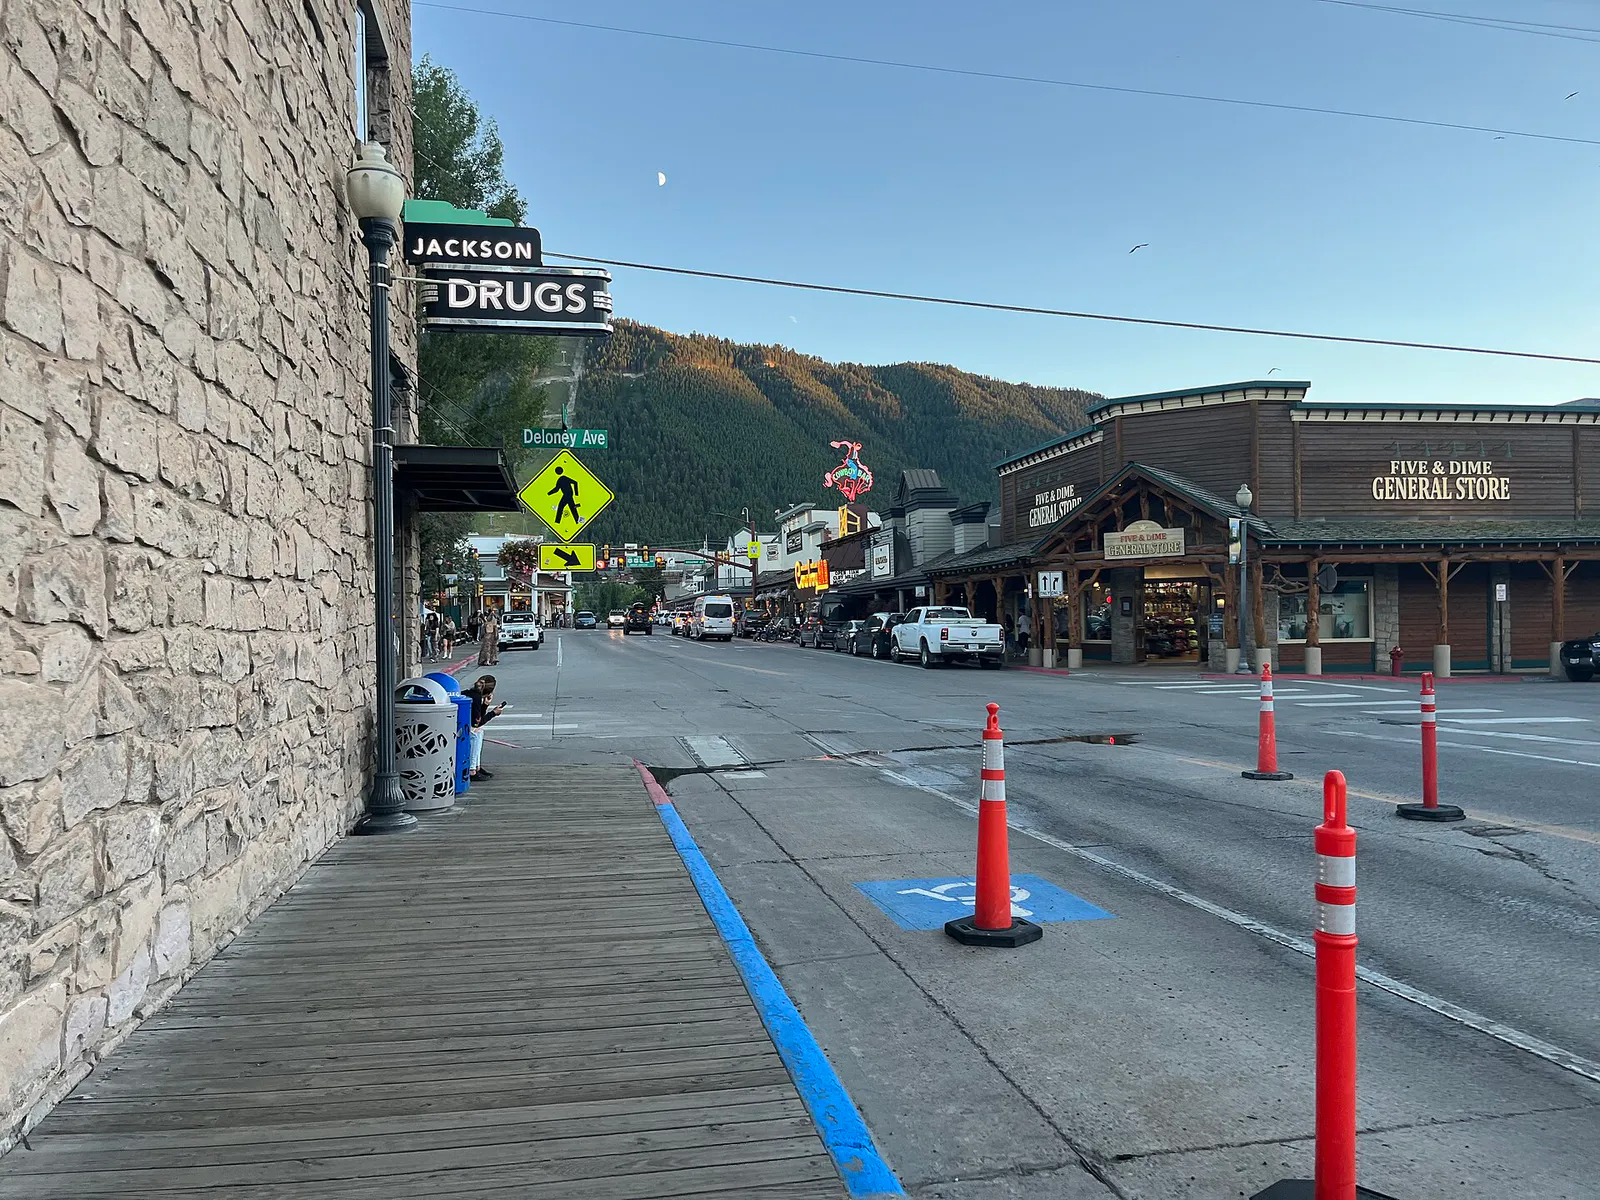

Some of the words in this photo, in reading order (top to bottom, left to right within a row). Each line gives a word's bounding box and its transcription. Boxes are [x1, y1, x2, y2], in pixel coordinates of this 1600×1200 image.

[412, 237, 532, 260] JACKSON
[448, 278, 587, 314] DRUGS
[523, 428, 577, 448] Deloney
[582, 429, 606, 445] Ave
[1390, 460, 1428, 475] FIVE
[1431, 460, 1445, 475] &
[1449, 460, 1492, 475] DIME
[1035, 491, 1050, 506] FIVE
[1050, 490, 1056, 502] &
[1056, 484, 1074, 500] DIME
[1372, 477, 1452, 500] GENERAL
[1455, 477, 1510, 500] STORE
[1030, 503, 1059, 527] GENERAL
[1108, 543, 1150, 556] GENERAL
[1150, 541, 1180, 554] STORE
[1120, 534, 1137, 543] FIVE
[1138, 533, 1145, 542] &
[1146, 532, 1167, 541] DIME
